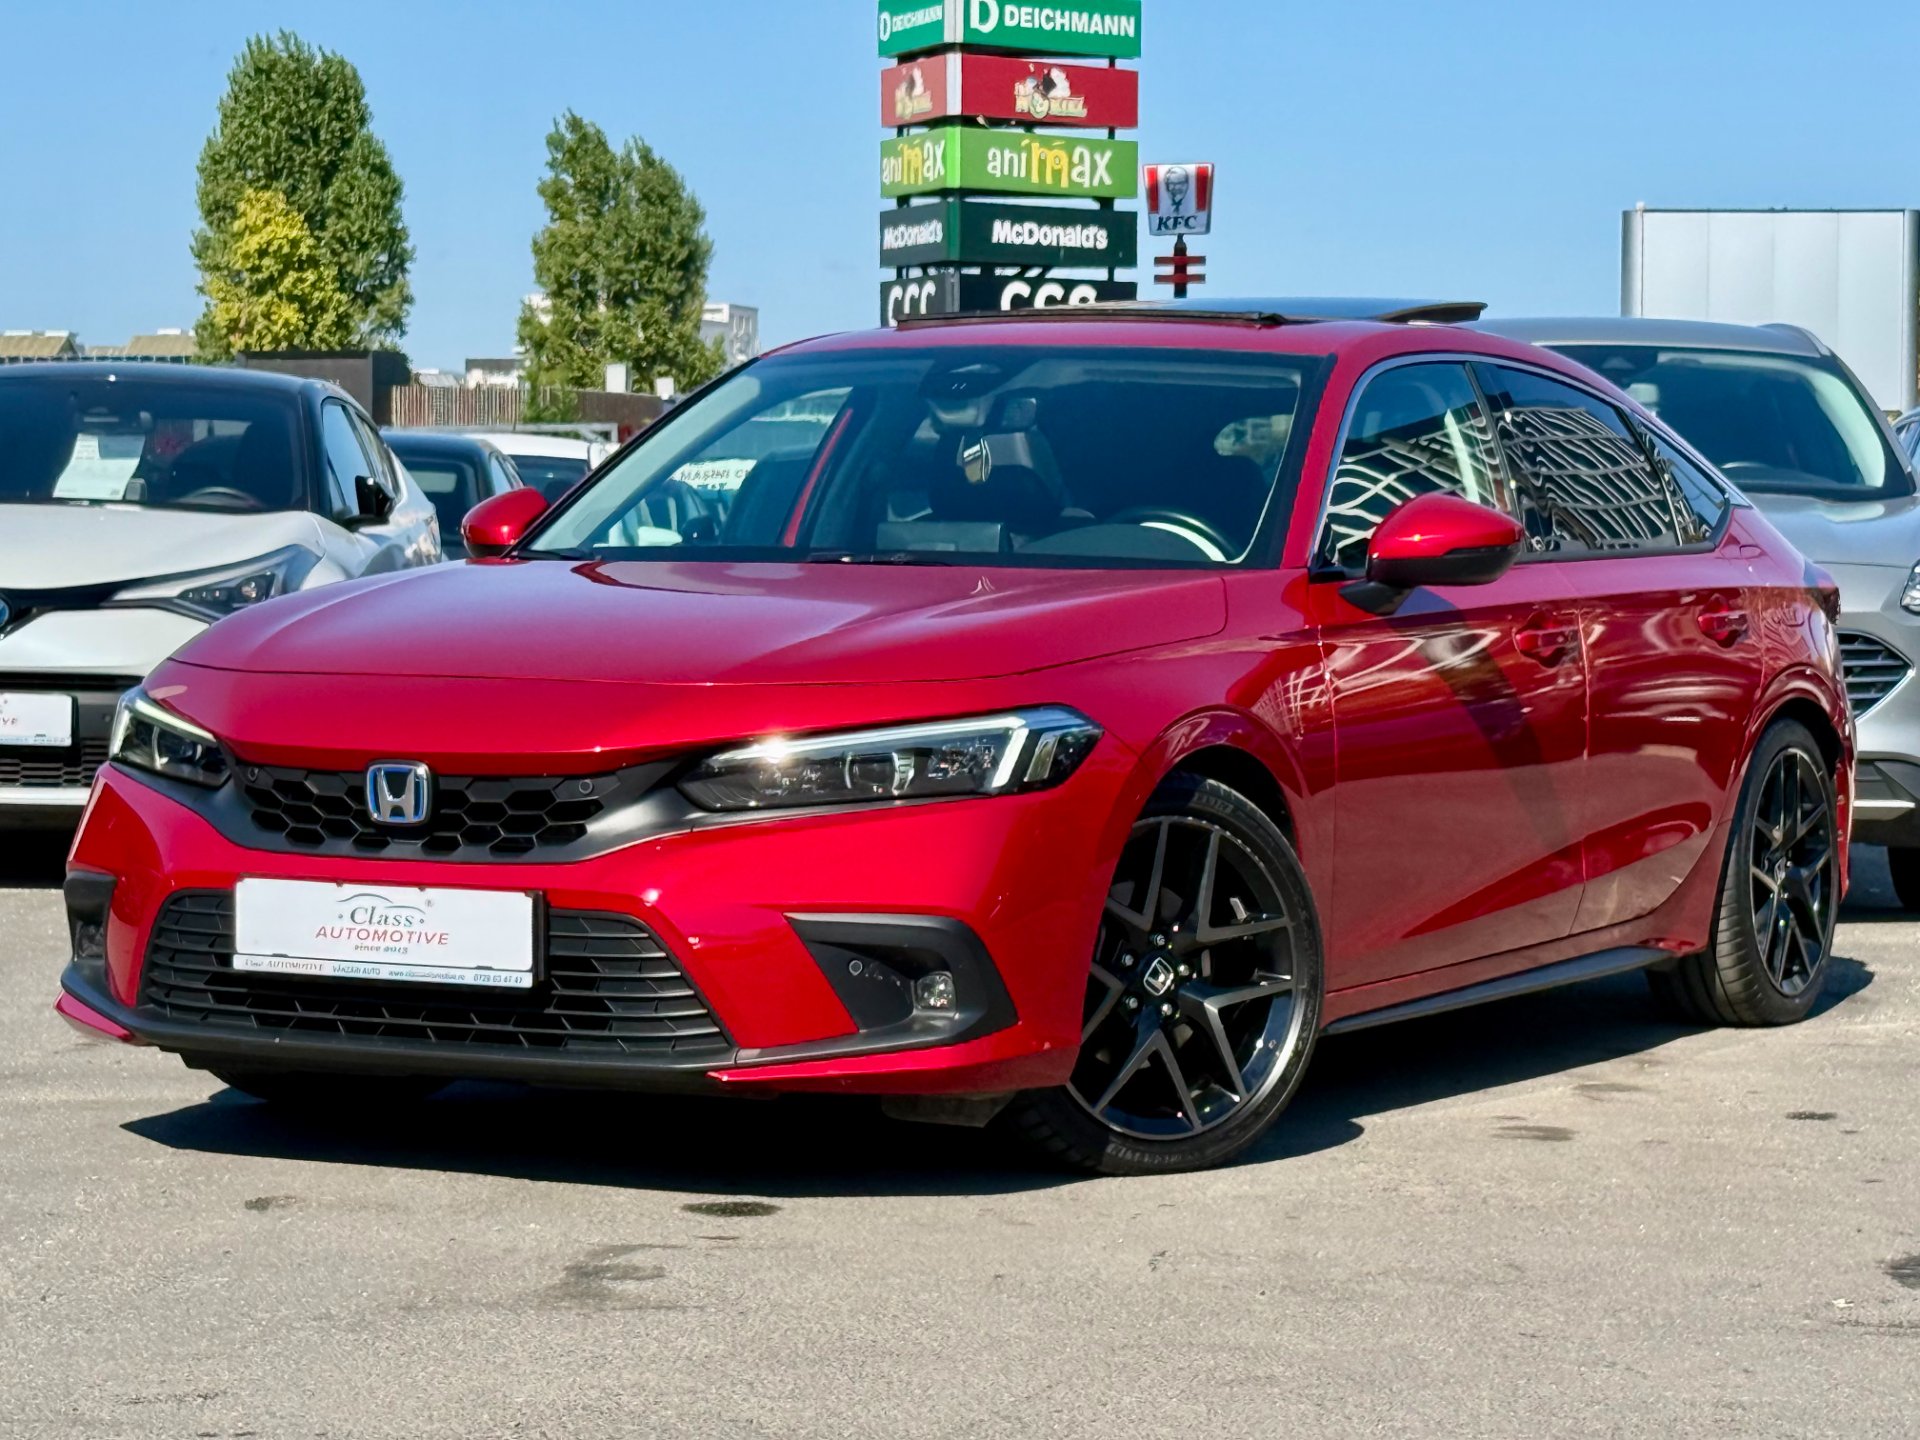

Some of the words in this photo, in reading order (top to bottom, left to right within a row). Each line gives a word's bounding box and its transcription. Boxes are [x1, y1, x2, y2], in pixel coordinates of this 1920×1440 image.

[892, 5, 943, 32] DEICHMANN
[1004, 4, 1135, 38] DEICHMANN
[882, 139, 946, 185] animax
[987, 139, 1112, 188] animax
[883, 219, 943, 250] McDonald's
[992, 219, 1109, 249] McDonald's
[1156, 215, 1198, 231] KFC
[350, 906, 415, 928] Class
[315, 926, 450, 945] AUTOMOTIVE
